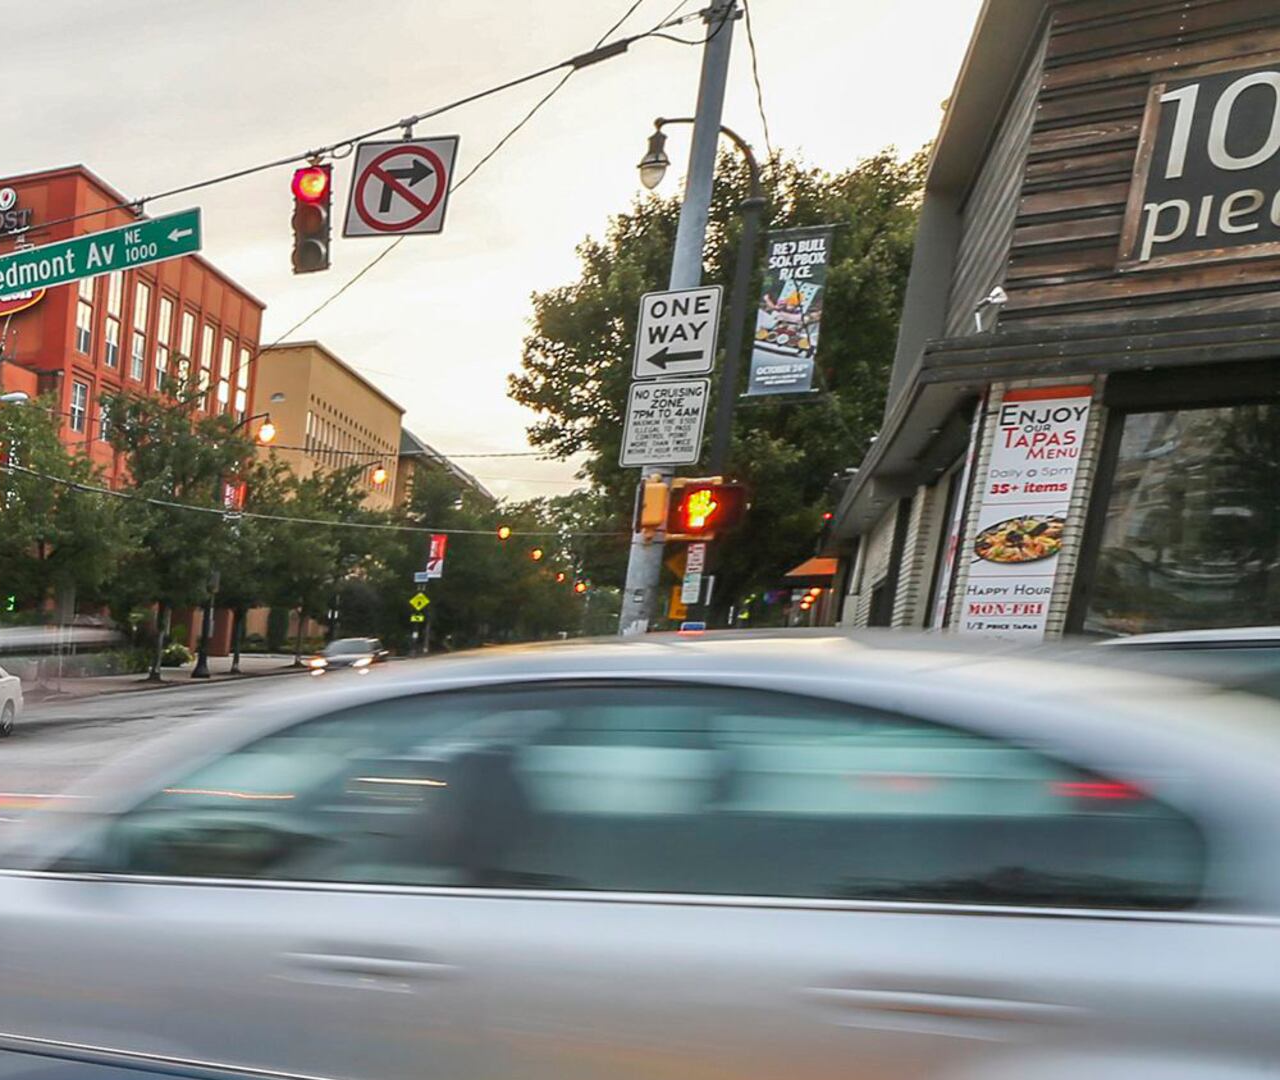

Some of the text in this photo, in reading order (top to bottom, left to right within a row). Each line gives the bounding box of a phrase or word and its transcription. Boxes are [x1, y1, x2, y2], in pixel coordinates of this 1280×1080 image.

[1159, 71, 1280, 179] 10
[1140, 189, 1280, 262] pie
[124, 229, 141, 245] NE
[125, 243, 157, 263] 1000
[797, 239, 825, 253] BULL
[86, 242, 115, 269] Av
[650, 295, 711, 319] ONE
[648, 320, 708, 344] WAY
[635, 386, 702, 399] NO CRUISING
[650, 398, 685, 409] ZONE
[632, 407, 700, 419] 7PM TO 4AM
[1024, 424, 1051, 433] OUR
[1026, 447, 1078, 460] MENU
[1041, 466, 1073, 477] 5pm
[989, 481, 1068, 495] 35+ items
[968, 602, 1044, 615] MON-FRI
[966, 622, 984, 630] 1/2
